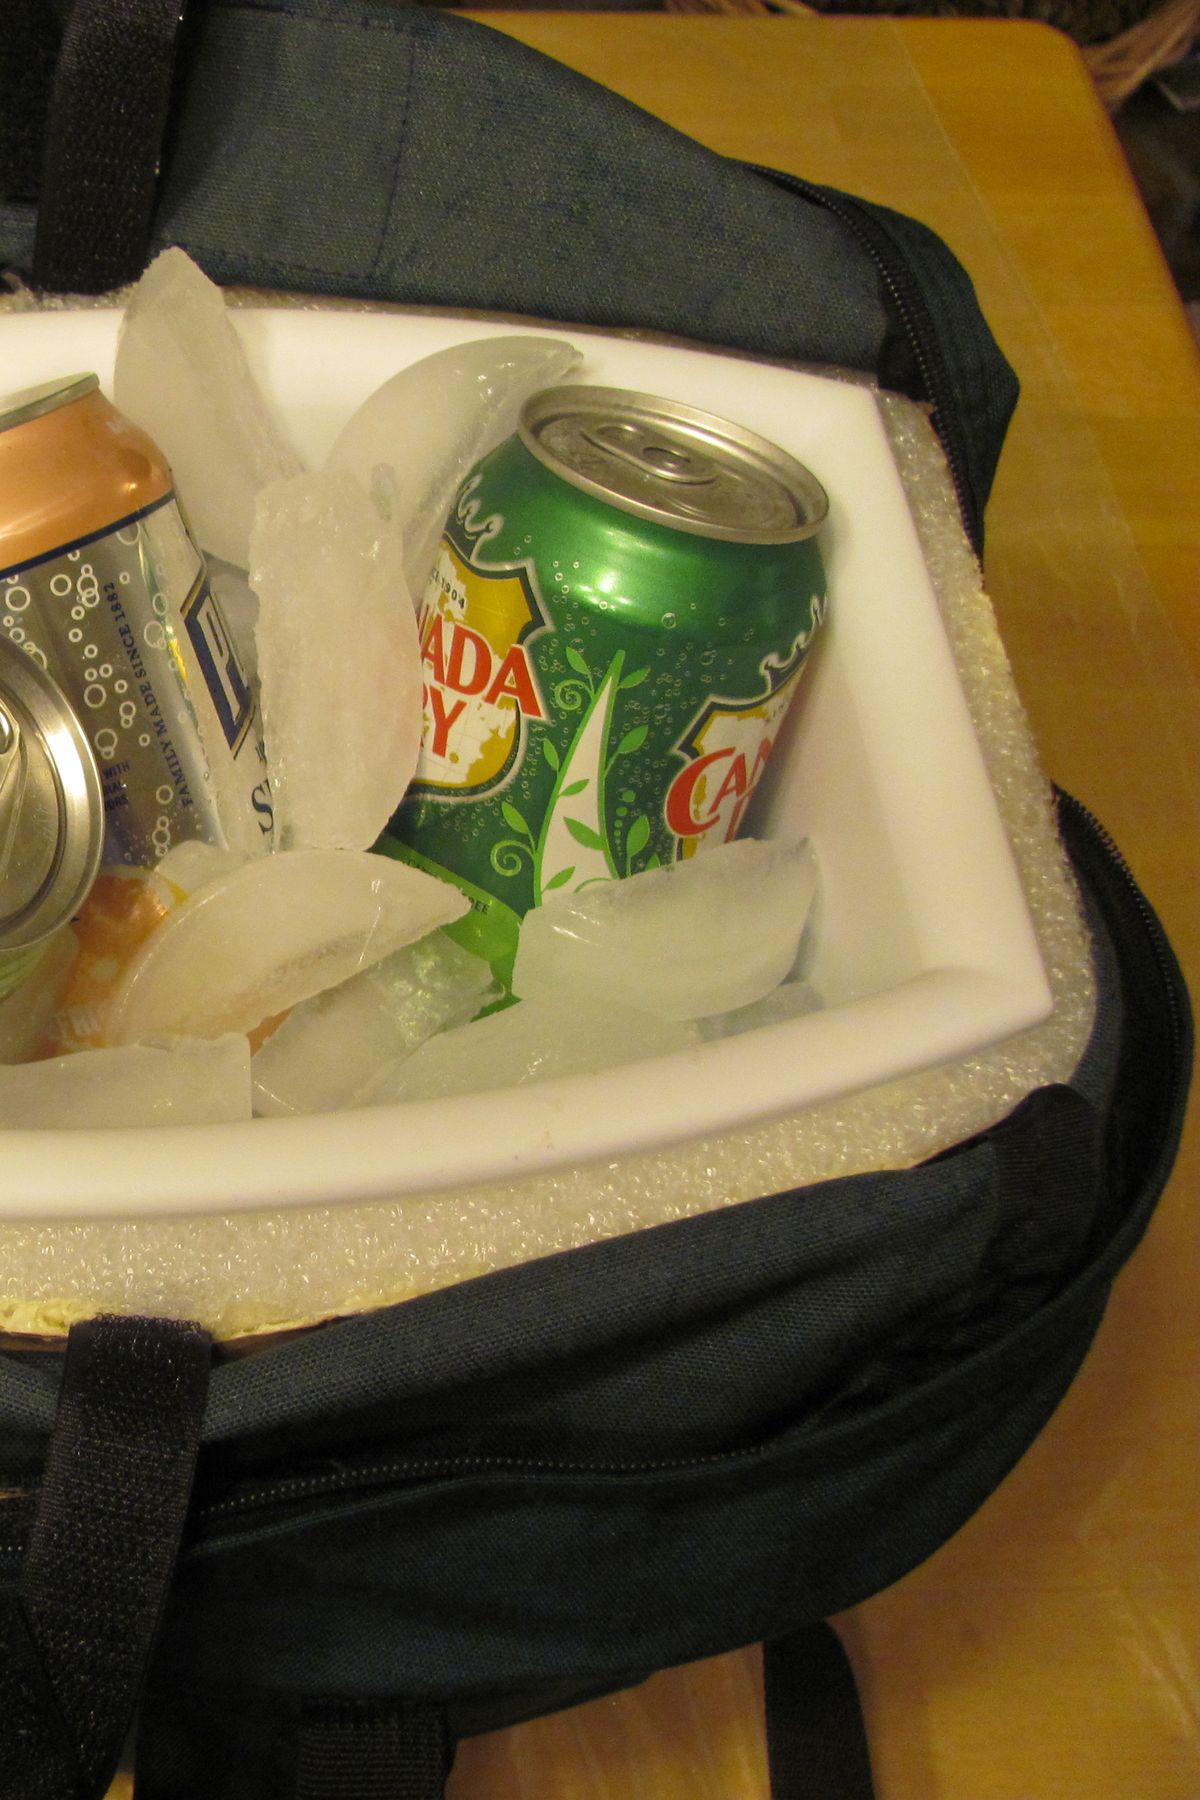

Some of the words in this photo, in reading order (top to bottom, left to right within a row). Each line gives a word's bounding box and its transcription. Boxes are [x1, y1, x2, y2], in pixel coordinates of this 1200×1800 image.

[103, 582, 126, 622] 1882
[441, 577, 465, 610] 1904
[118, 624, 147, 679] SINCE
[139, 681, 167, 738] MADE
[160, 739, 194, 810] FAMILY
